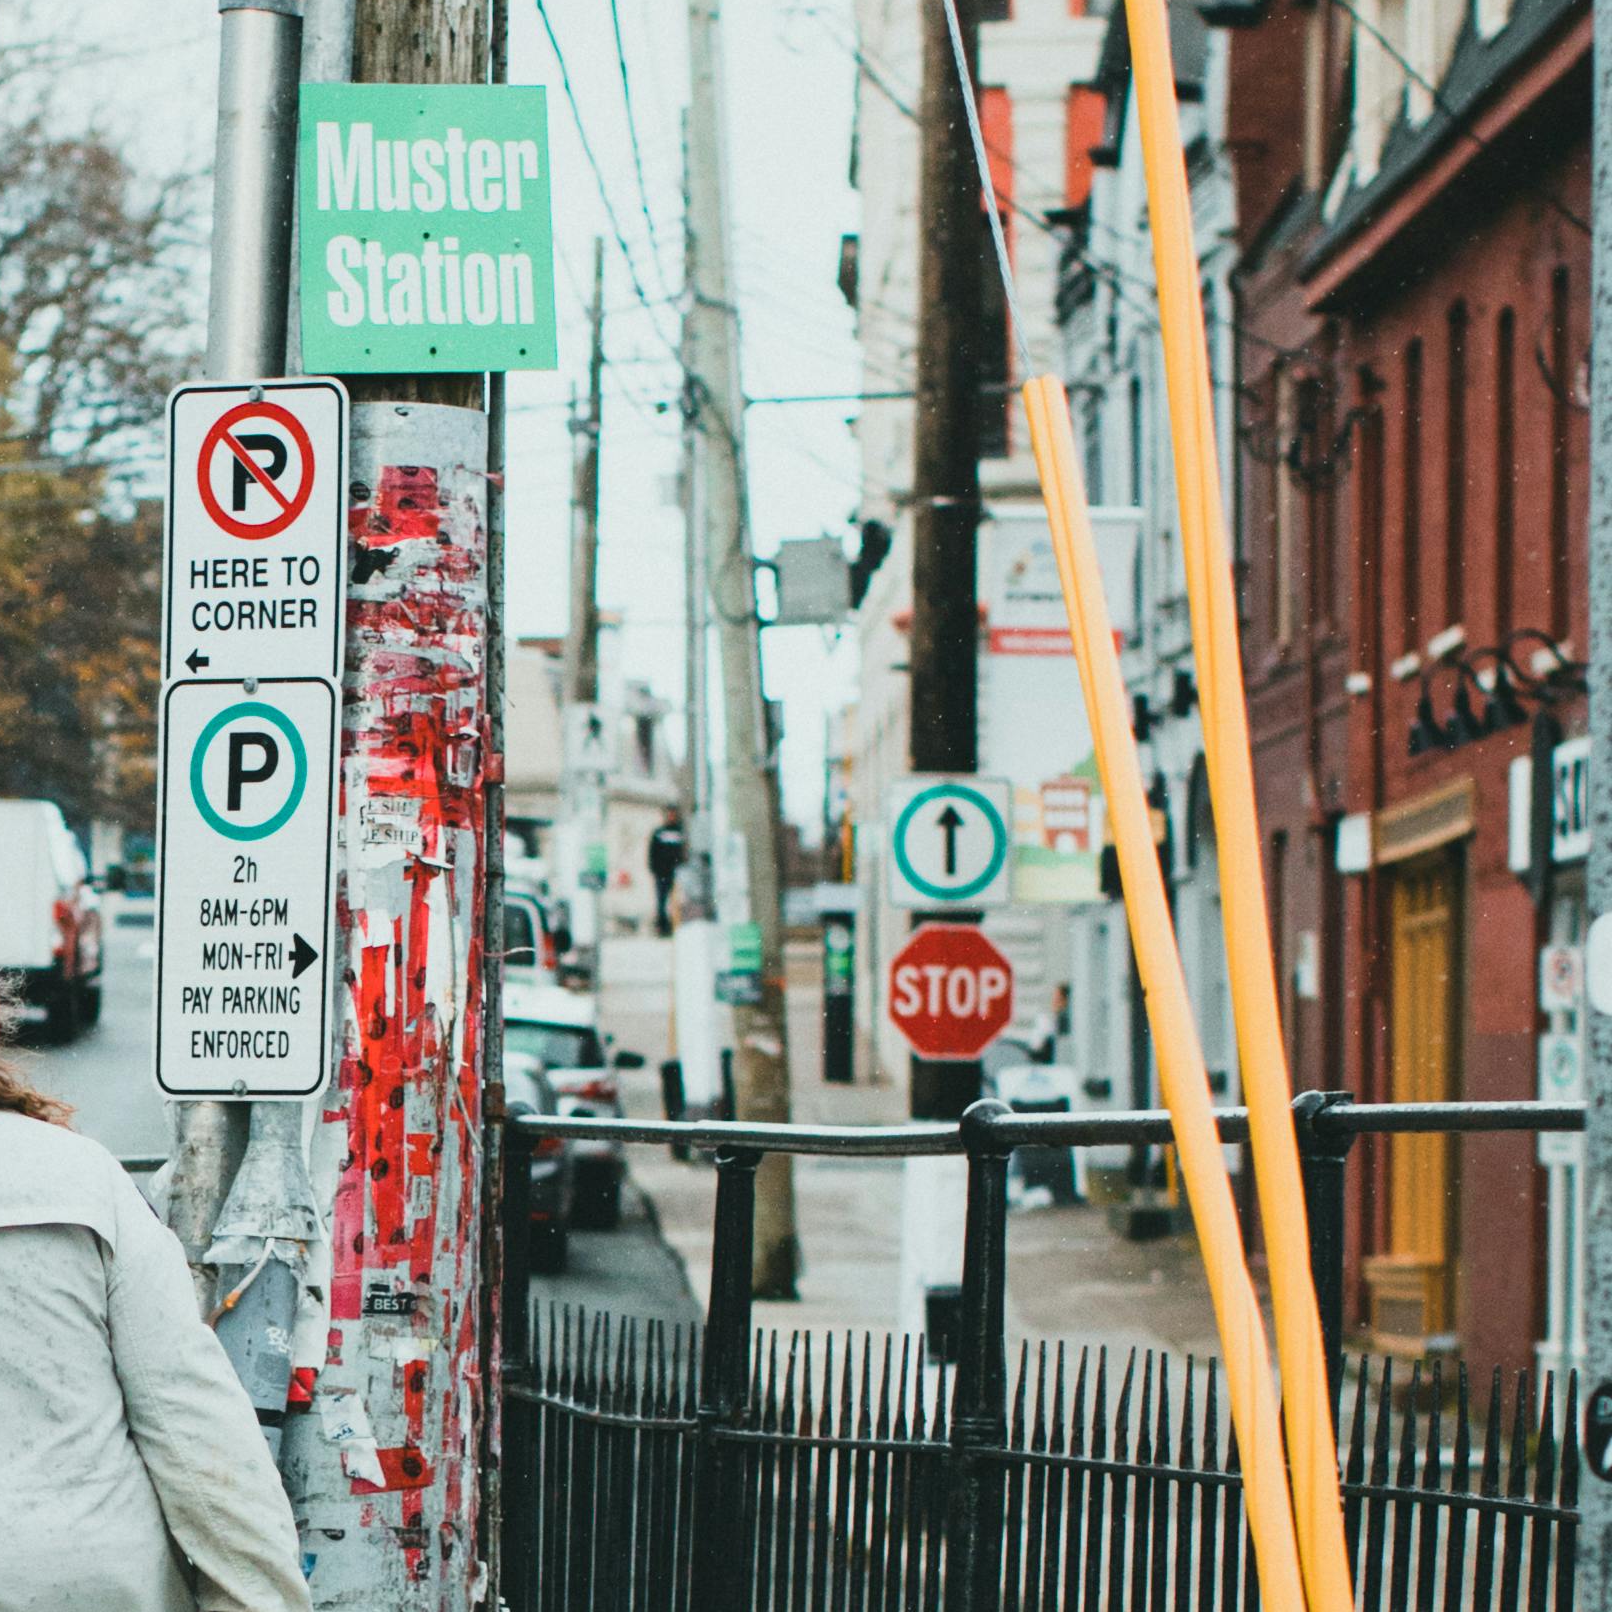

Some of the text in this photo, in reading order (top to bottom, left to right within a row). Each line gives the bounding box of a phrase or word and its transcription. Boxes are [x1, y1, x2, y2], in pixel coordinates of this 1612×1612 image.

[316, 120, 538, 213] Muster
[325, 234, 536, 327] Station
[232, 433, 288, 512] P
[190, 555, 321, 589] HERE TO
[191, 598, 318, 632] CORNER
[227, 731, 280, 812] P
[233, 854, 258, 884] 2h
[199, 897, 289, 928] 8AM-6PM
[201, 941, 284, 972] MON-FRI
[181, 985, 301, 1016] PAY PARKING
[892, 964, 1010, 1020] STOP
[190, 1029, 290, 1059] ENFORCED
[373, 1298, 407, 1311] BEST
